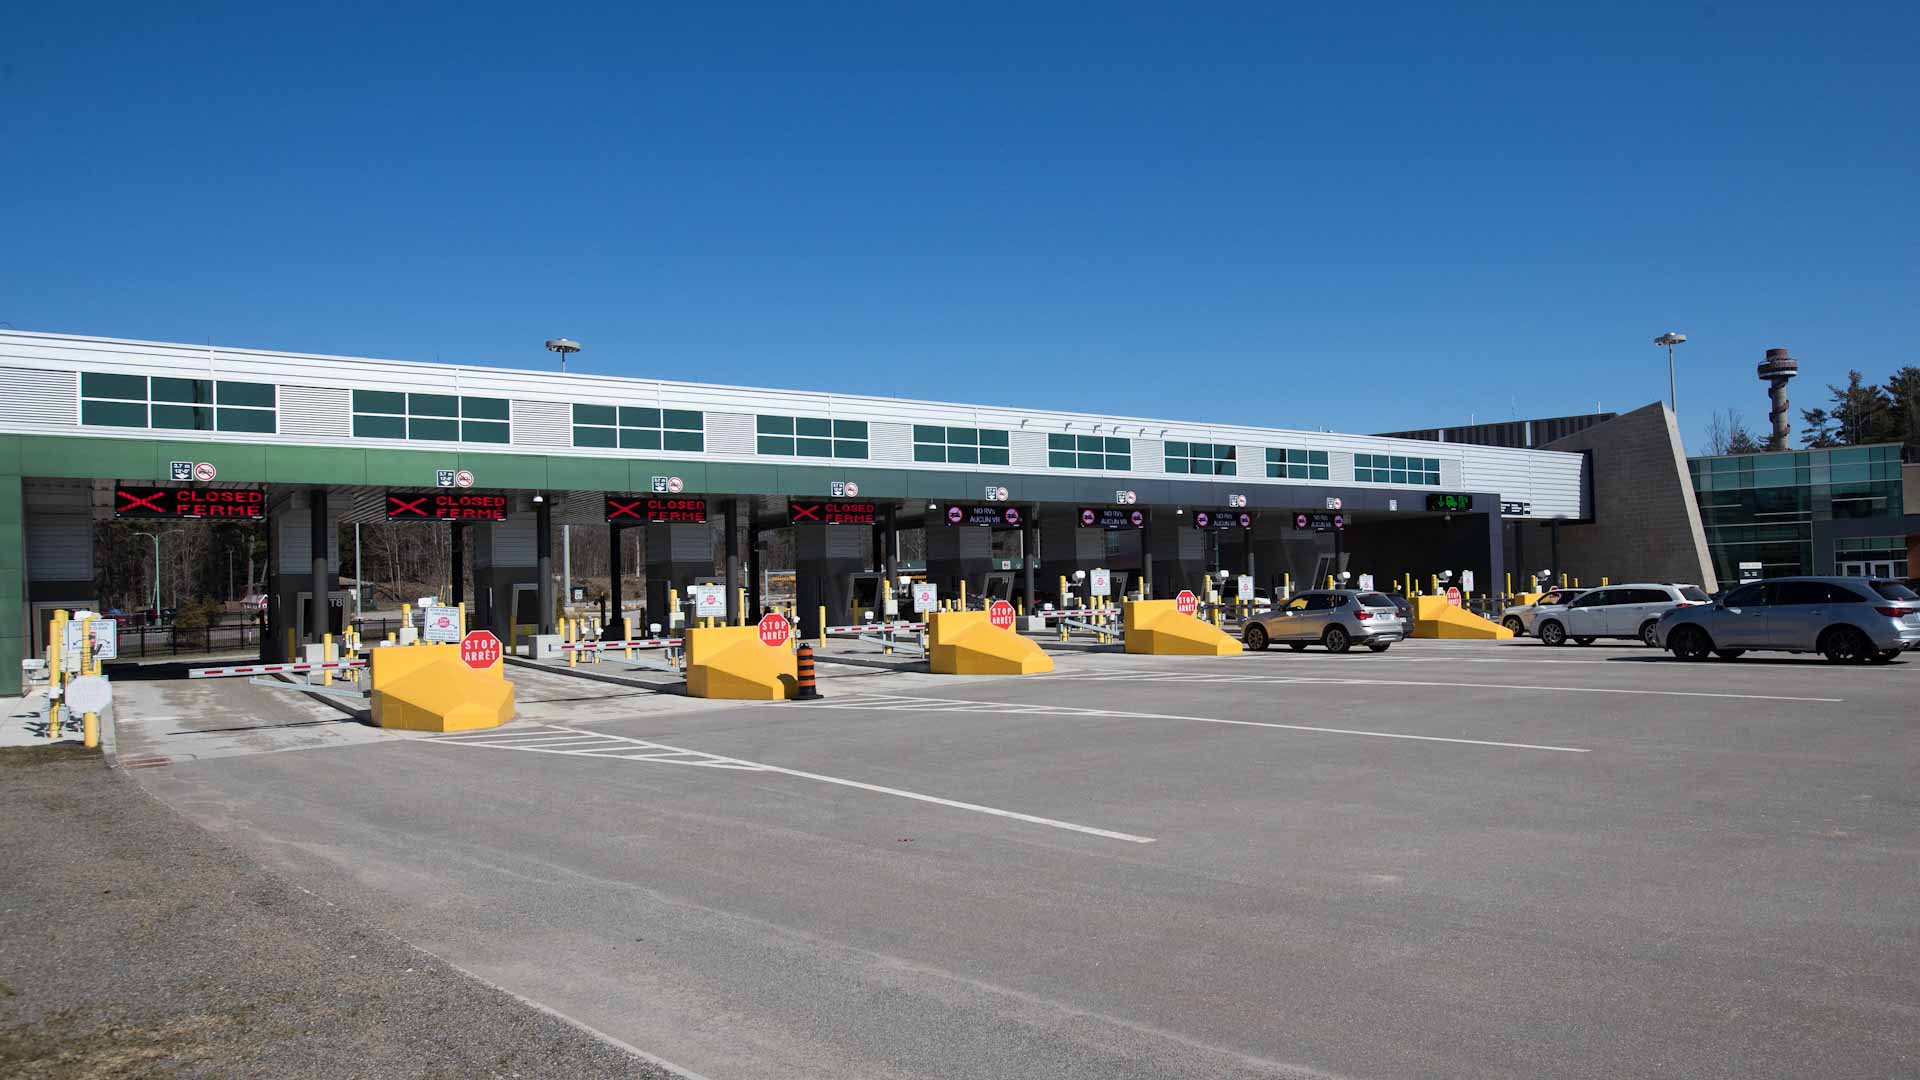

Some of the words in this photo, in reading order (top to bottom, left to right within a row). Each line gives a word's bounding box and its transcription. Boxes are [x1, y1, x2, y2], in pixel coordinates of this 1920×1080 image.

[176, 490, 262, 503] CLOSED
[436, 495, 506, 507] CLOSED
[647, 500, 705, 510] CLOSED
[825, 503, 874, 513] CLOSED
[329, 599, 343, 608] T8
[1178, 596, 1195, 604] STOP
[991, 607, 1012, 616] STOP
[762, 620, 787, 630] STOP
[762, 630, 787, 641] ARRÊT
[465, 639, 497, 650] STOP
[464, 649, 497, 662] ARRÊT
